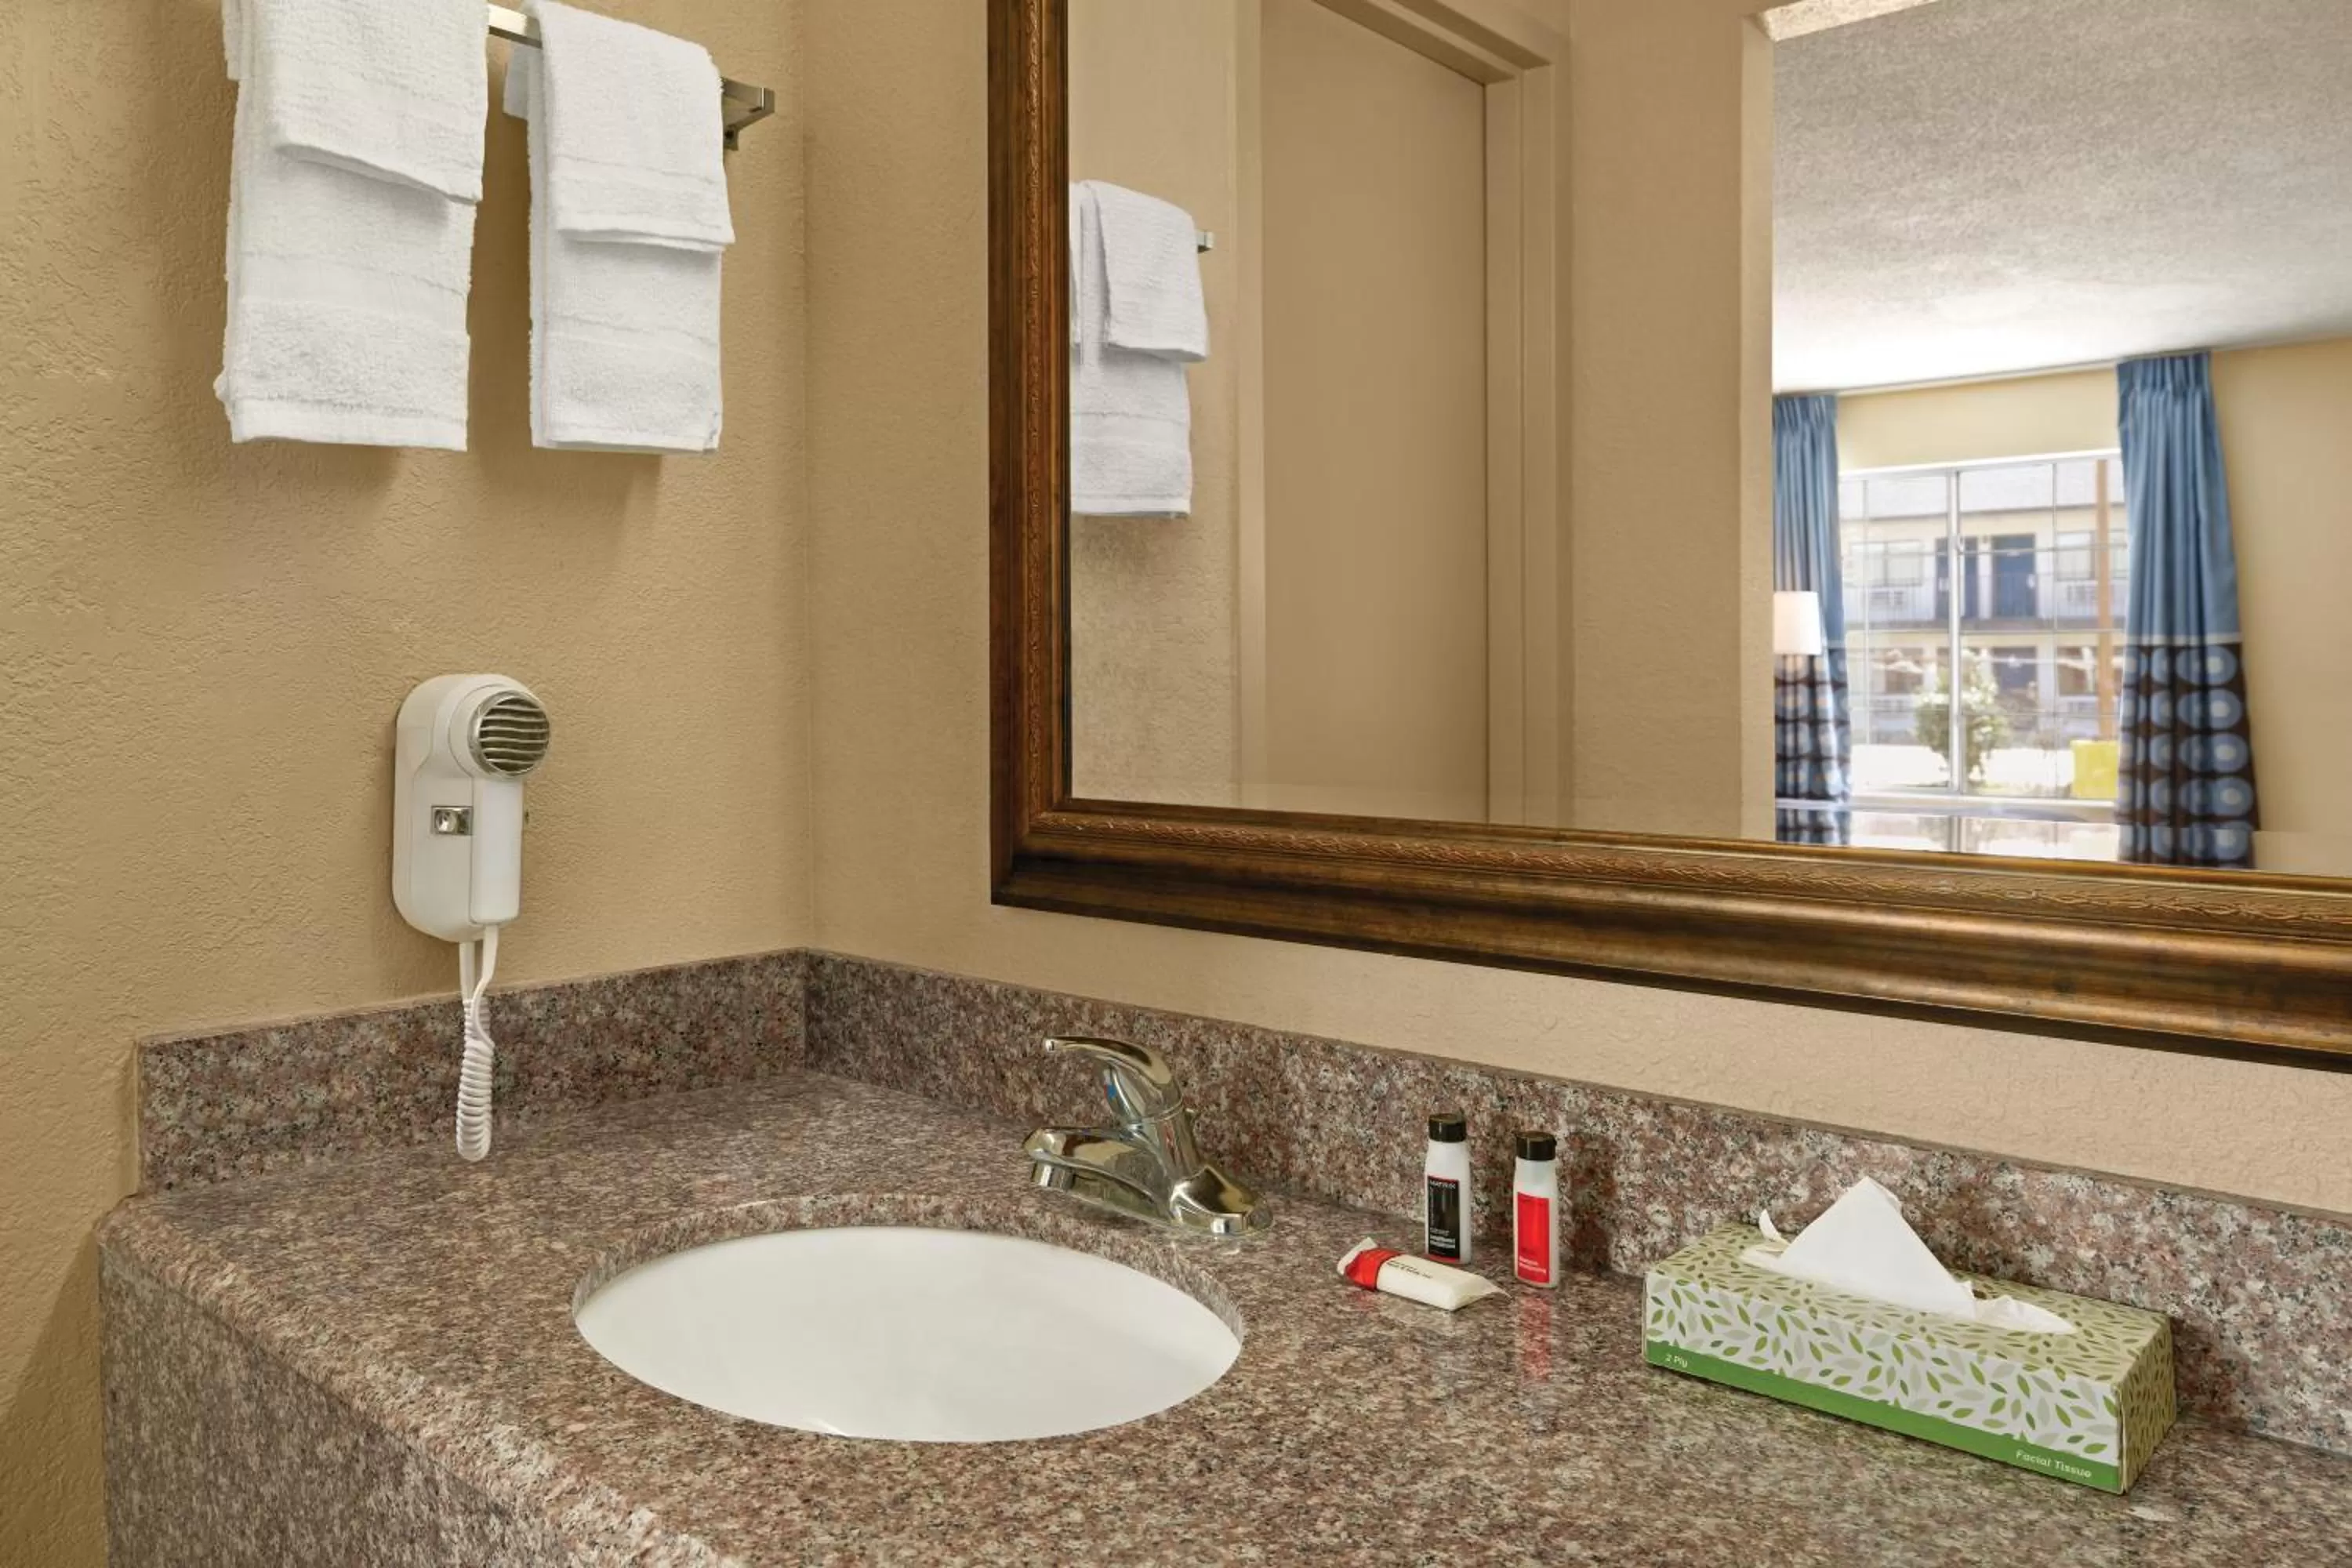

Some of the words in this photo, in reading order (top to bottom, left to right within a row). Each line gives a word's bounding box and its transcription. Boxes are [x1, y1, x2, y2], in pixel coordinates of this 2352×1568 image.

[1664, 1353, 1671, 1362] 2
[1674, 1356, 1688, 1368] Ply
[2016, 1450, 2052, 1467] Facial
[2055, 1460, 2092, 1478] Tissue
